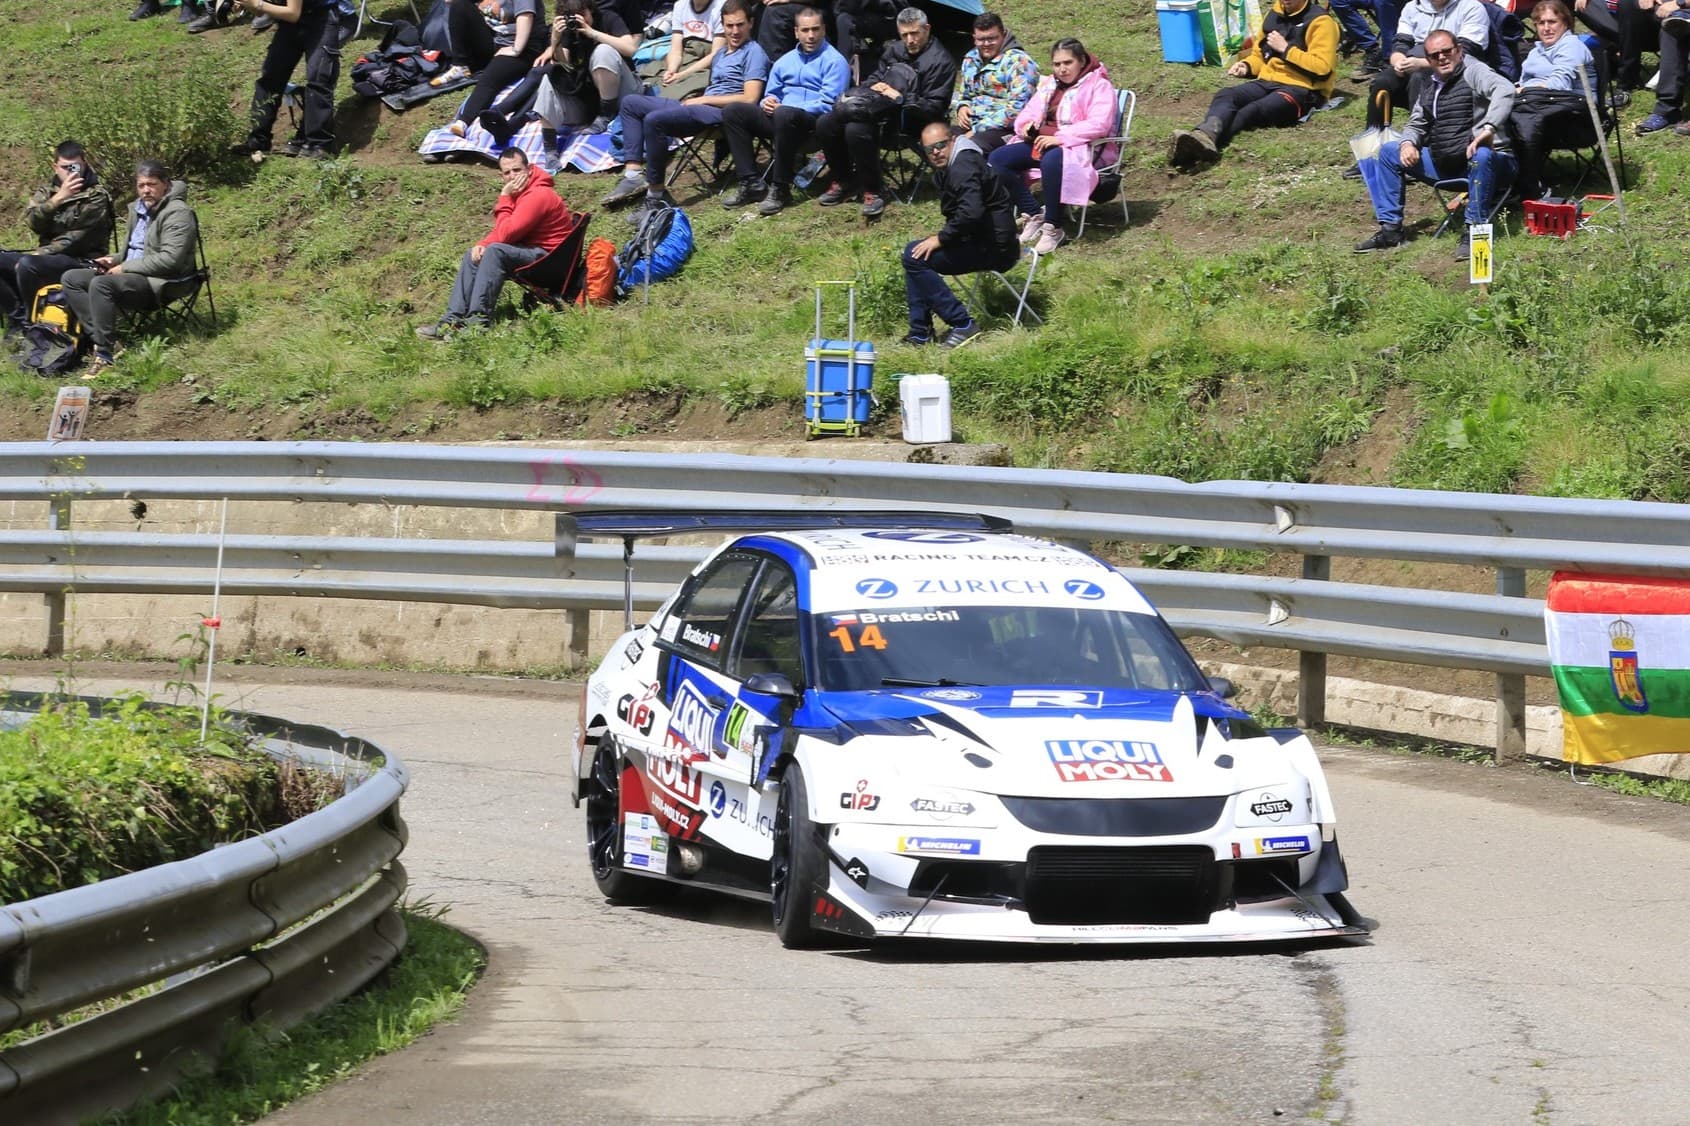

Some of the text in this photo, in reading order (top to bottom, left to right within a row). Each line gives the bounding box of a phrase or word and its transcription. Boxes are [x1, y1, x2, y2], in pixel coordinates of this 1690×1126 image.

[873, 553, 957, 562] RACING
[913, 579, 1050, 594] ZURICH
[829, 624, 888, 653] 14
[671, 688, 714, 758] LIQUI
[726, 704, 748, 749] 14
[1049, 740, 1159, 763] LIQUI
[1059, 762, 1165, 781] MOLY
[917, 799, 969, 814] FASTEC
[1254, 801, 1290, 815] FASTEC
[730, 798, 777, 841] ZUICH
[919, 840, 972, 851] MICHELIN
[1272, 840, 1305, 850] MICHELIN
